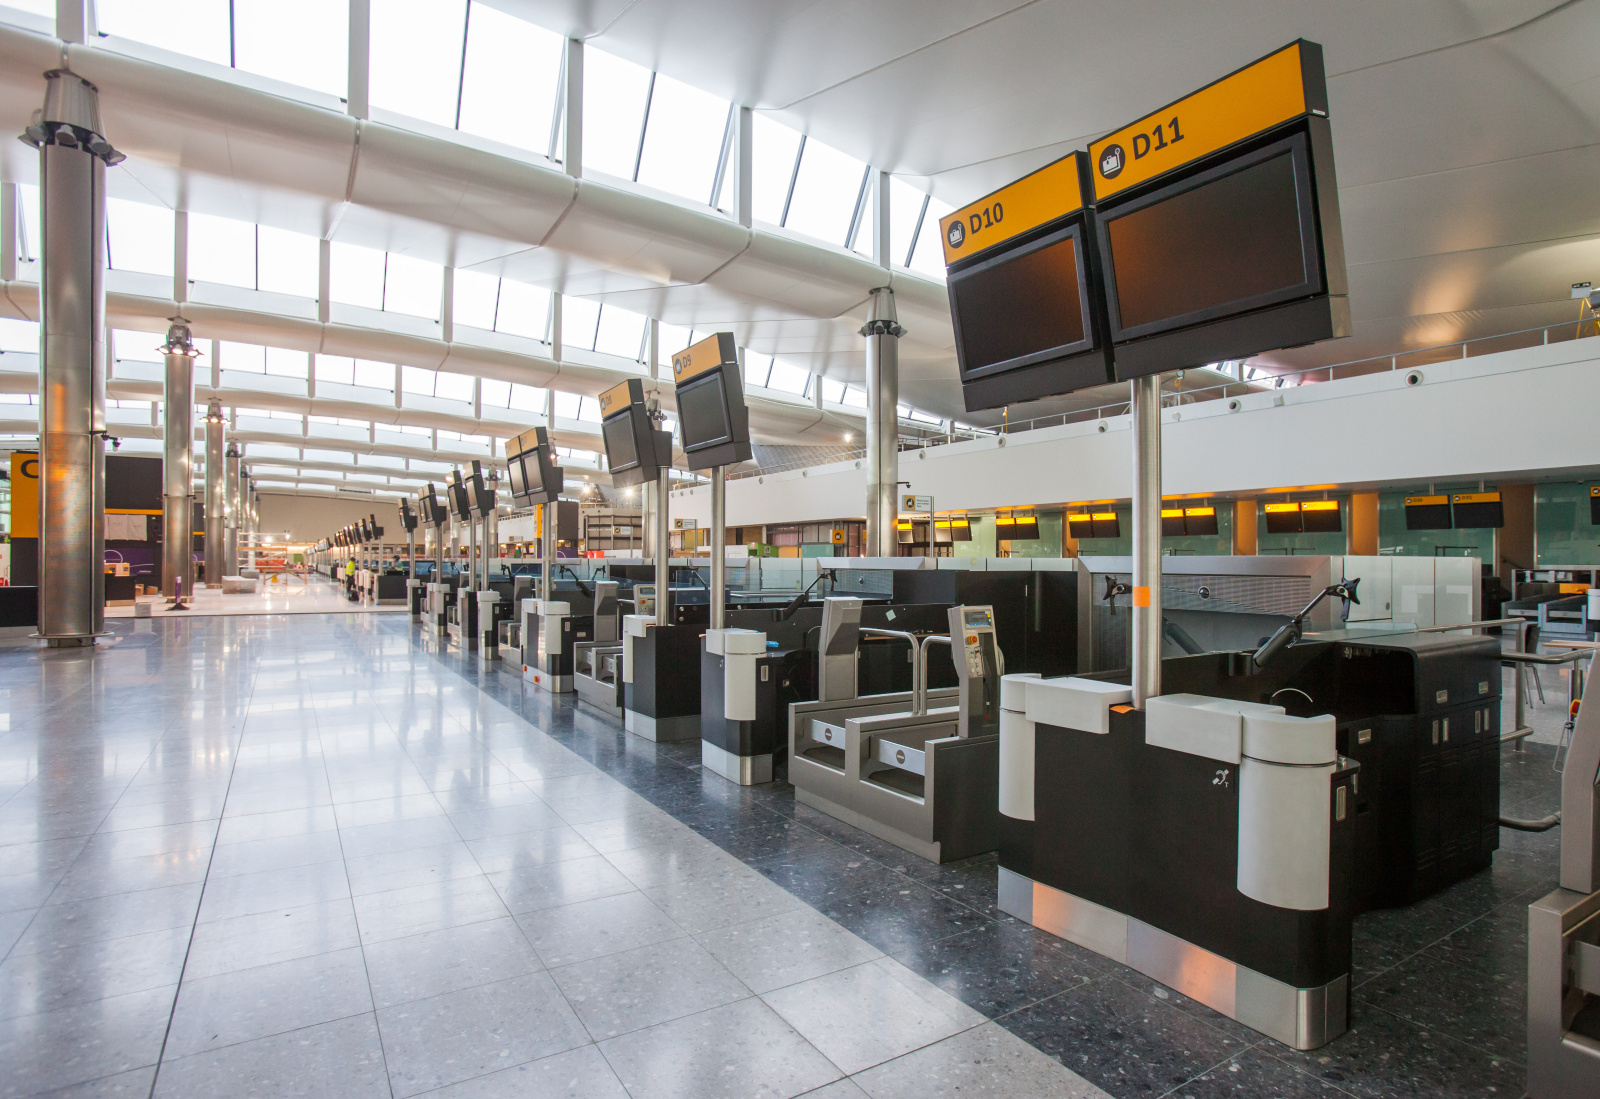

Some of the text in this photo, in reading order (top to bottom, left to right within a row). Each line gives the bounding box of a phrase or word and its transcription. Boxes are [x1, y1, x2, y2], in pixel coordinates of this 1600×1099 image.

[1132, 116, 1184, 160] D11
[970, 202, 1003, 234] D10
[682, 354, 691, 368] D9
